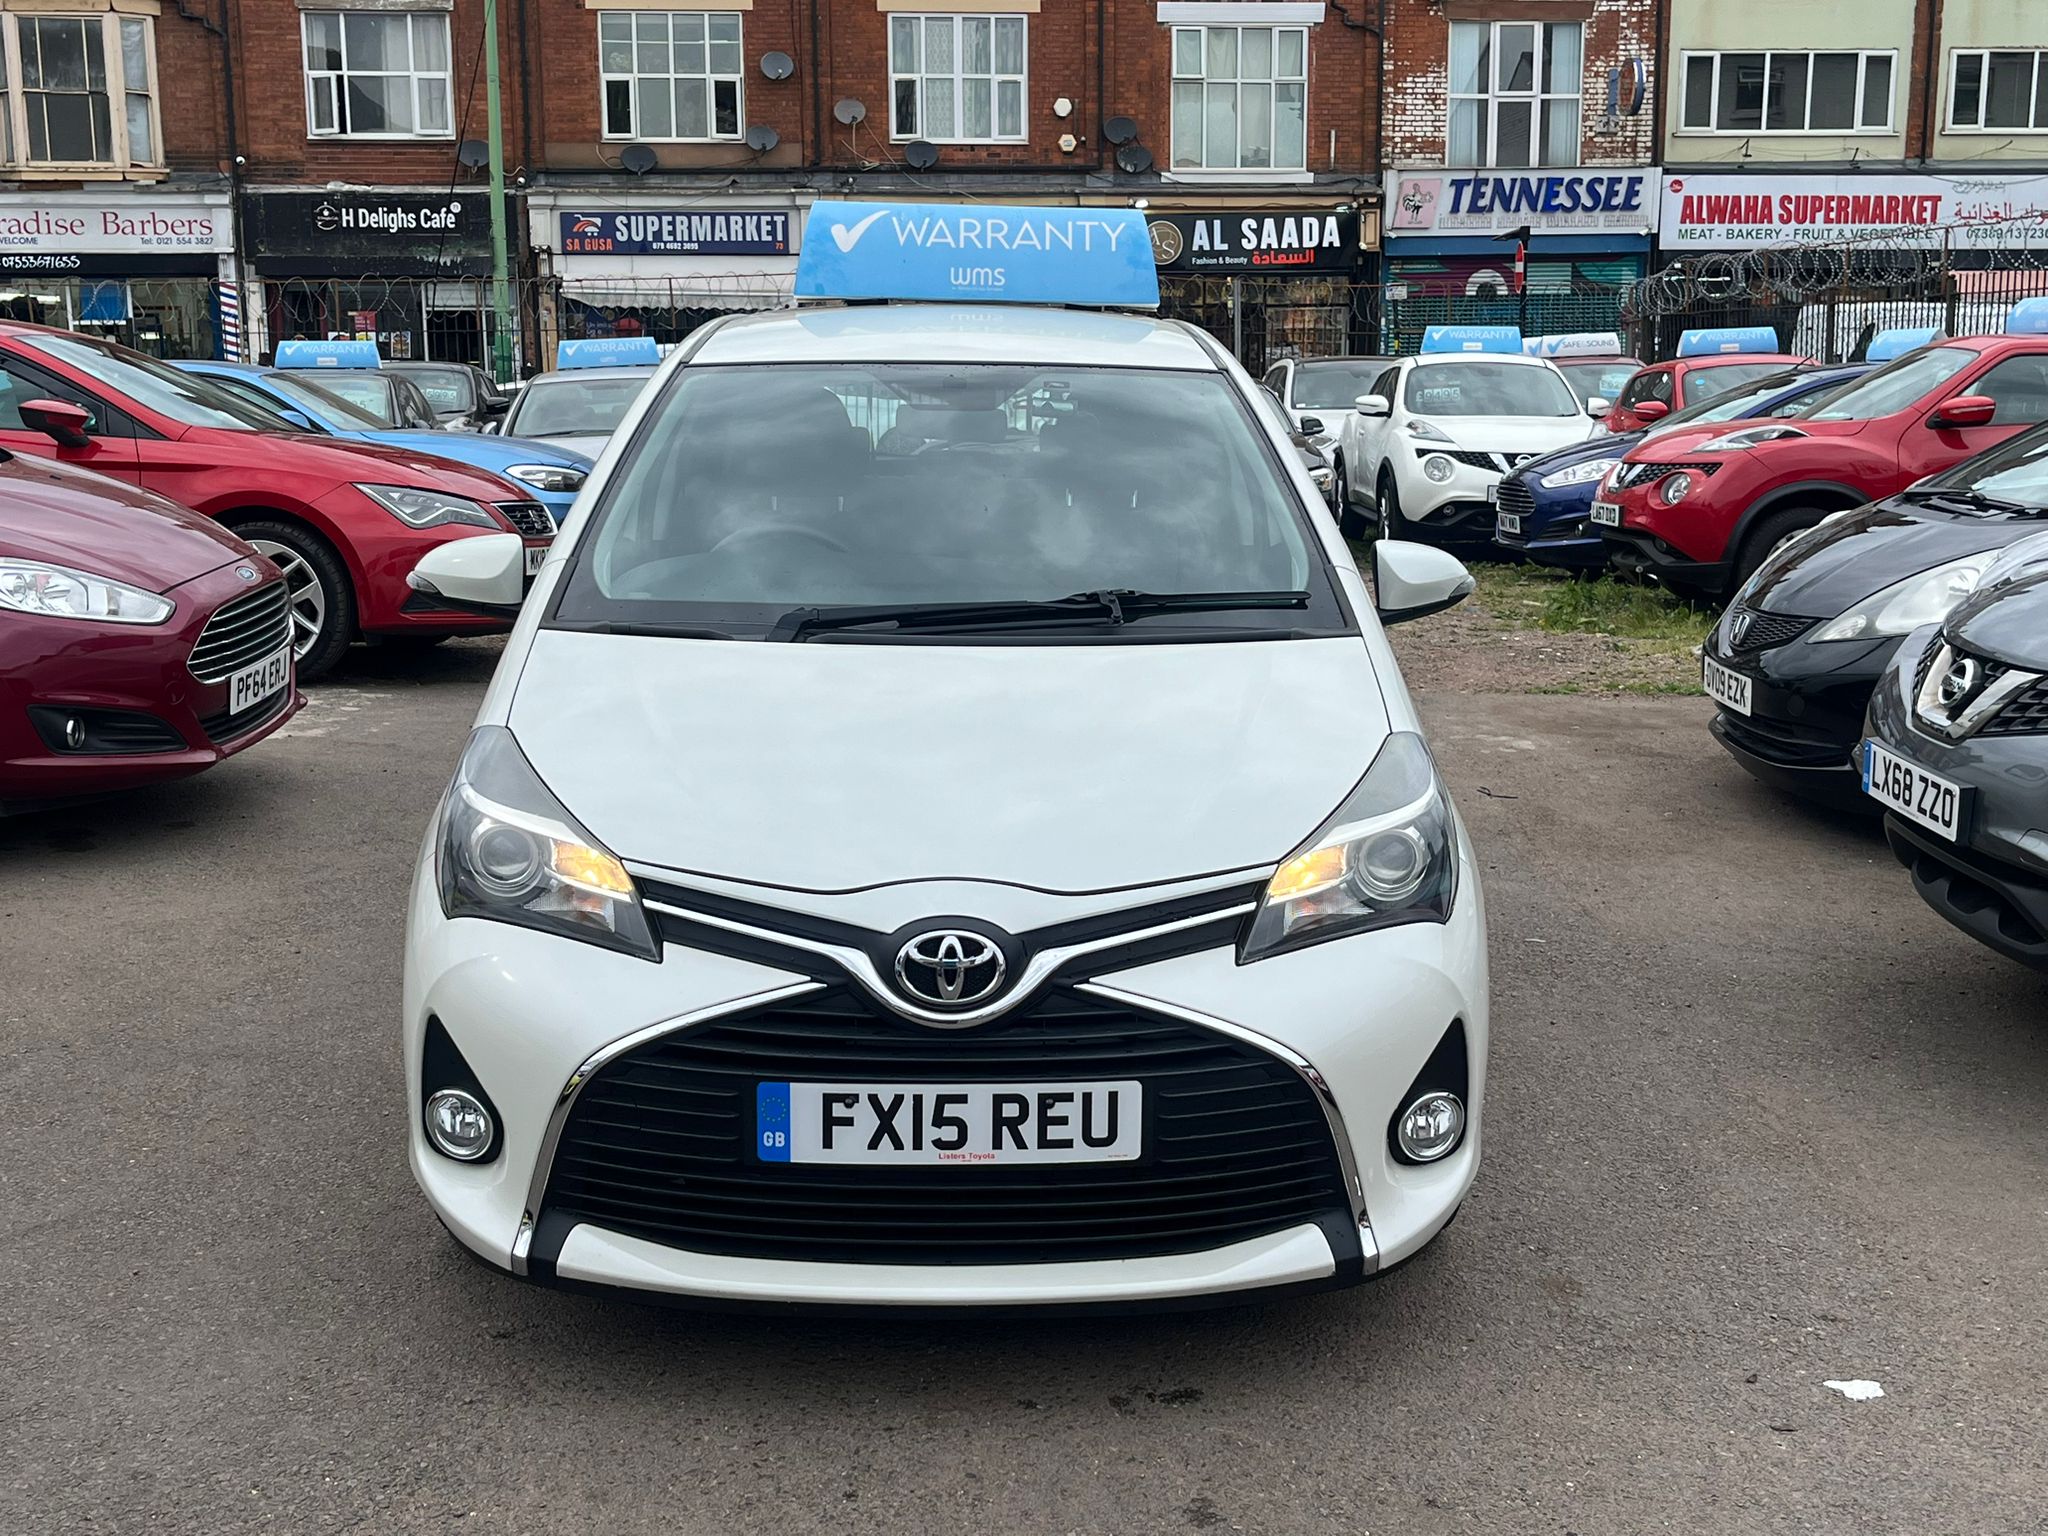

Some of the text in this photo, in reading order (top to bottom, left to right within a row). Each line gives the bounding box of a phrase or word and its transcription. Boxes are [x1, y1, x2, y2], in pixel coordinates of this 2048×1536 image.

[1448, 176, 1644, 214] TENNESSEE
[1680, 195, 1773, 224] ALWAHA
[1779, 195, 1942, 225] SUPERMARKET
[101, 211, 213, 236] Barbers
[341, 207, 456, 233] H Delighs Cafe
[615, 215, 785, 242] SUPERMARKET
[157, 237, 172, 245] 0121
[177, 237, 192, 245] 554
[195, 237, 213, 245] 3827
[891, 216, 1126, 252] WARRANTY
[1192, 216, 1341, 250] AL SAADA
[1678, 229, 1713, 239] MEAT
[1726, 229, 1782, 240] BAKERY
[1794, 229, 1831, 240] FRUIT
[1838, 229, 1850, 239] &
[566, 238, 613, 251] SA GUSA
[1192, 257, 1217, 265] Fashion
[1225, 256, 1248, 265] Beauty
[1252, 249, 1314, 265] السعادة
[951, 267, 1005, 286] wms
[1450, 329, 1514, 340] WARRANTY
[1705, 330, 1769, 342] WARRANTY
[302, 344, 370, 354] WARRANTY
[582, 342, 649, 352] WARRANTY
[237, 653, 287, 706] PF64 ERJ
[1727, 674, 1746, 708] EZK
[1872, 751, 1913, 807] LX68
[822, 1091, 1119, 1150] FX15 REU
[763, 1132, 785, 1147] GB
[968, 1152, 995, 1161] Toyota
